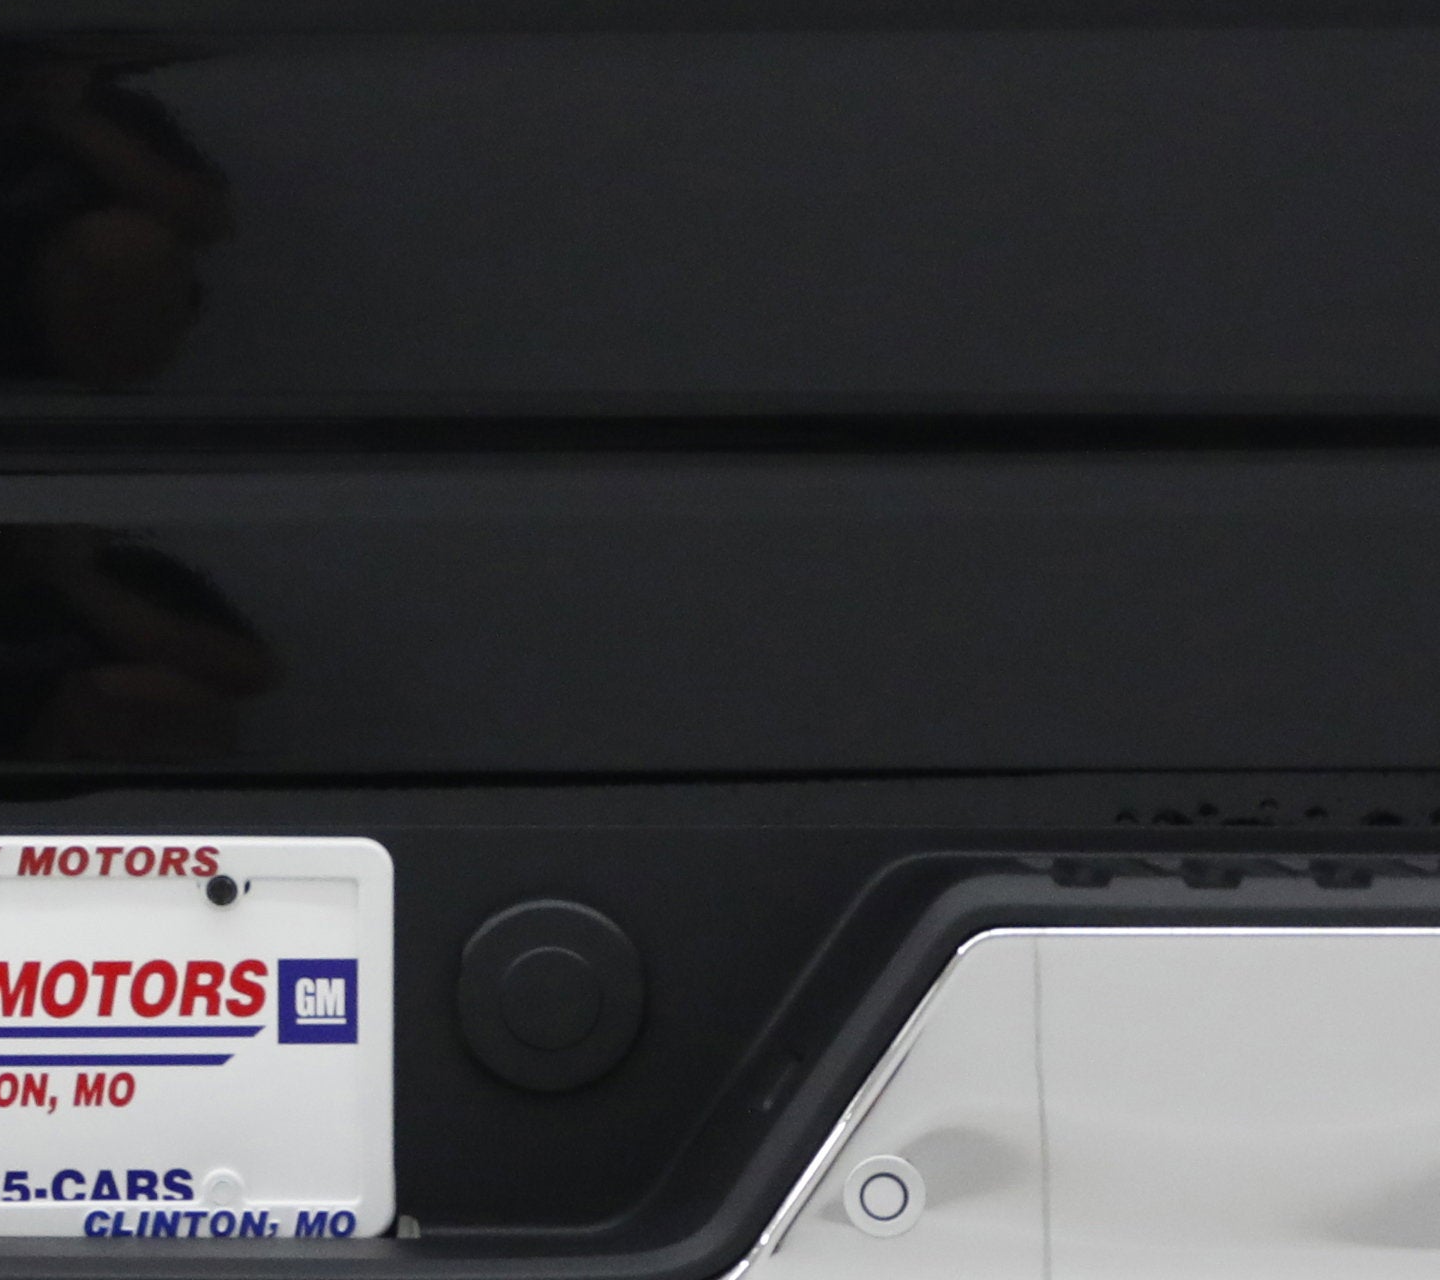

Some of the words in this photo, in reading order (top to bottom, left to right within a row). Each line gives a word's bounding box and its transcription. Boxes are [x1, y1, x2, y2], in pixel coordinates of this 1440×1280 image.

[16, 846, 220, 878] MOTORS
[294, 977, 347, 1018] GM
[73, 1072, 135, 1108] MO
[294, 1210, 357, 1238] MO
